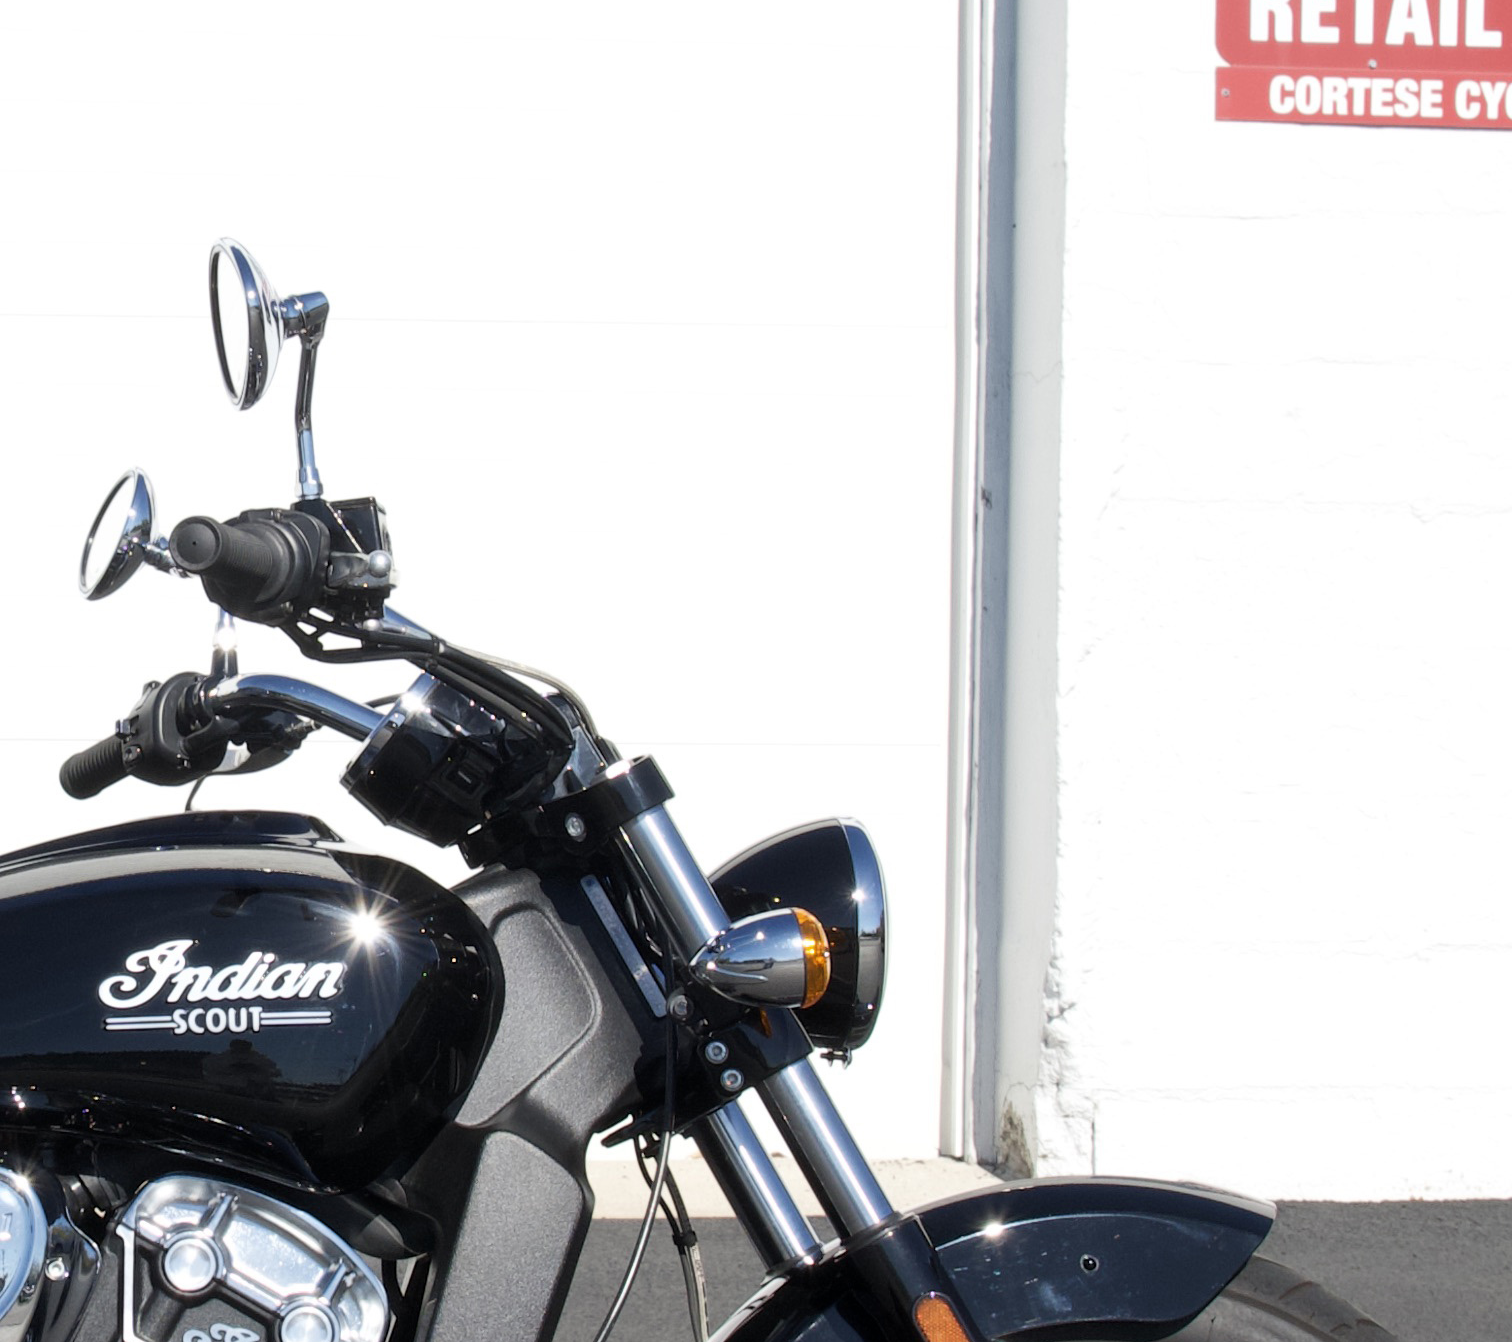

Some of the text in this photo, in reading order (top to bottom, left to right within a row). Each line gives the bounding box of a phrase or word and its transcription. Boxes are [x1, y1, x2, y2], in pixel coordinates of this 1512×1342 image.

[1268, 75, 1444, 119] CORTESE
[98, 939, 347, 1008] Indian
[172, 1006, 263, 1034] SCOUT
